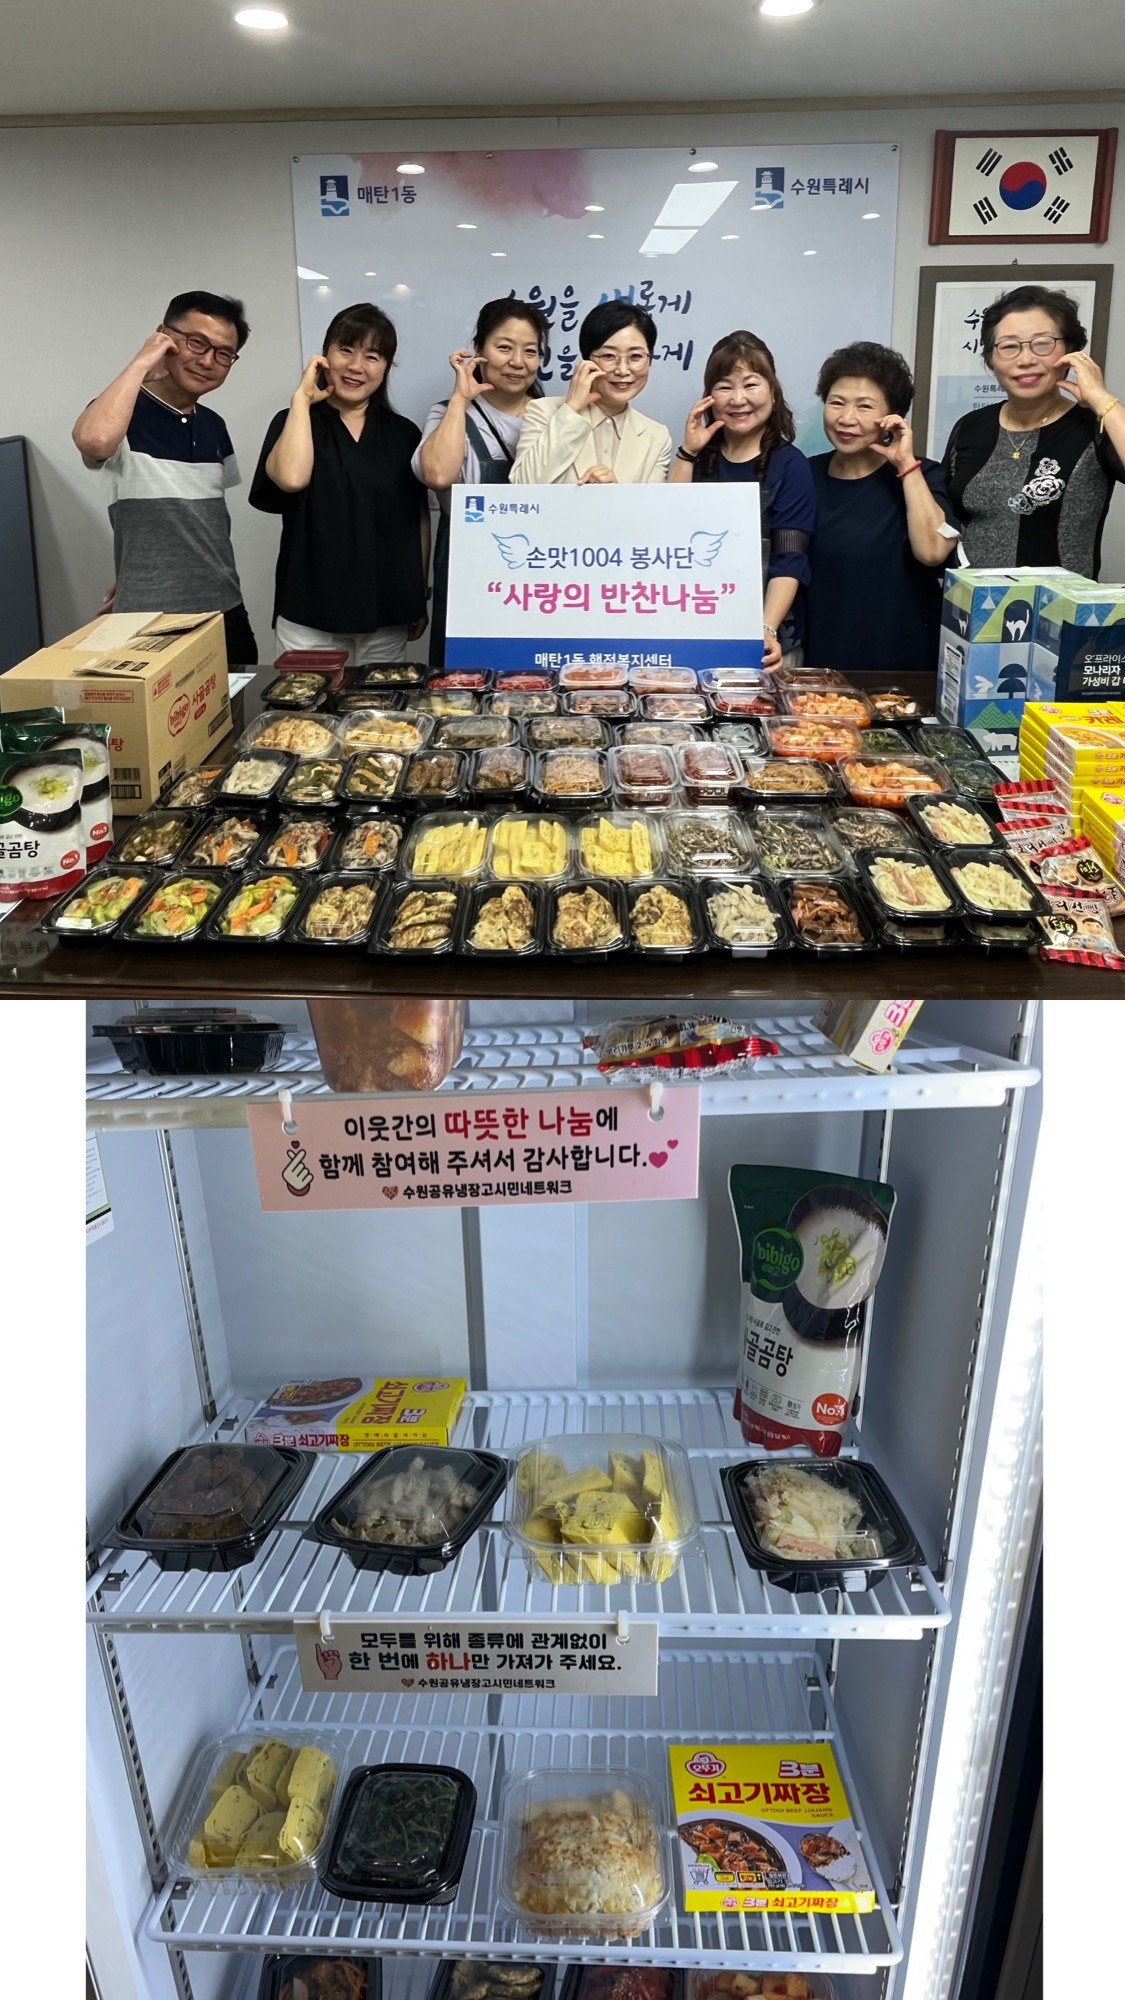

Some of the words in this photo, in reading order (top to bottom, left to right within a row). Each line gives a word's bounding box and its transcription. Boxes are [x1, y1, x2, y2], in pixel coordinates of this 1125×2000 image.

[357, 185, 417, 204] 매탄1동
[790, 177, 869, 195] 수원특례시
[507, 285, 580, 332] 원을
[488, 503, 540, 514] 수원특례시
[526, 546, 623, 569] 손맛1004
[630, 546, 695, 569] 봉사단
[1083, 665, 1121, 676] 모나리자
[1082, 676, 1110, 687] 가성비
[92, 828, 108, 837] No.1
[62, 855, 79, 865] No.1
[344, 1113, 437, 1142] 이웃간의
[444, 1108, 529, 1140] 따뜻한
[538, 1106, 619, 1137] 나눔에
[319, 1153, 365, 1180] 함께
[371, 1150, 440, 1178] 참여해
[446, 1147, 515, 1176] 주셔서
[523, 1143, 648, 1173] 감사합니다.
[403, 1178, 573, 1200] 수원공유냉장고시민네트워크
[757, 1241, 801, 1275] bibigo
[761, 1263, 781, 1277] 비비고
[361, 1381, 409, 1425] 쇠고기짜장
[299, 1434, 350, 1447] 쇠고기짜장
[361, 1632, 416, 1649] 모두를
[424, 1632, 461, 1649] 위해
[468, 1632, 524, 1649] 종류에
[531, 1632, 607, 1650] 관계없이
[348, 1651, 371, 1671] 한
[378, 1651, 419, 1671] 번에
[425, 1651, 490, 1671] 하나만
[496, 1653, 553, 1670] 가져가
[559, 1654, 622, 1671] 주세요.
[418, 1678, 556, 1689] 수원공유냉장고시민네트워크
[692, 1764, 720, 1774] 오뚜기
[778, 1759, 825, 1779] 3분
[688, 1782, 831, 1805] 쇠고기짜장
[772, 1896, 840, 1909] 쇠고기짜장
